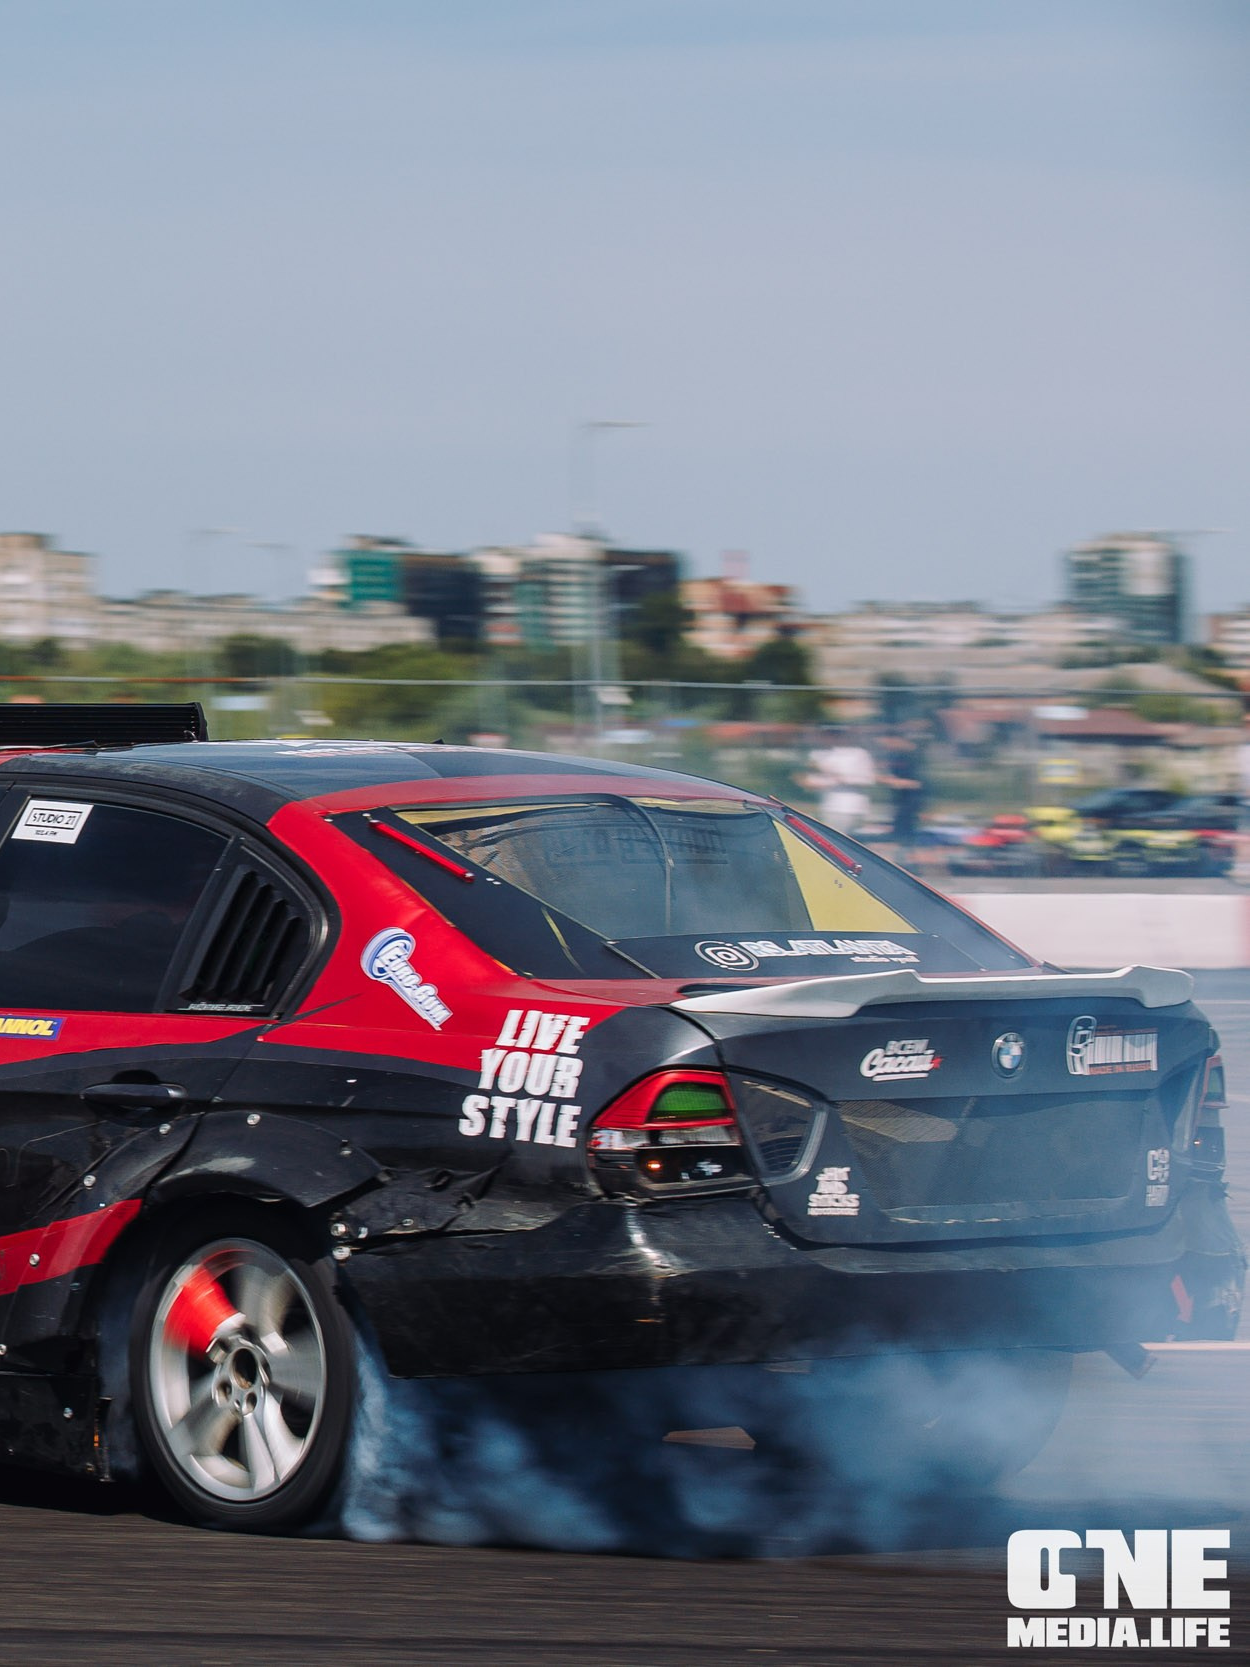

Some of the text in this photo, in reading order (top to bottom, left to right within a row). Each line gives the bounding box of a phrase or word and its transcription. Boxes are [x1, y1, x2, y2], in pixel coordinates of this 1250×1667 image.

[32, 813, 65, 824] STUDIO
[495, 1009, 590, 1054] LIVE
[478, 1048, 583, 1098] YOUR
[458, 1094, 582, 1148] STYLE
